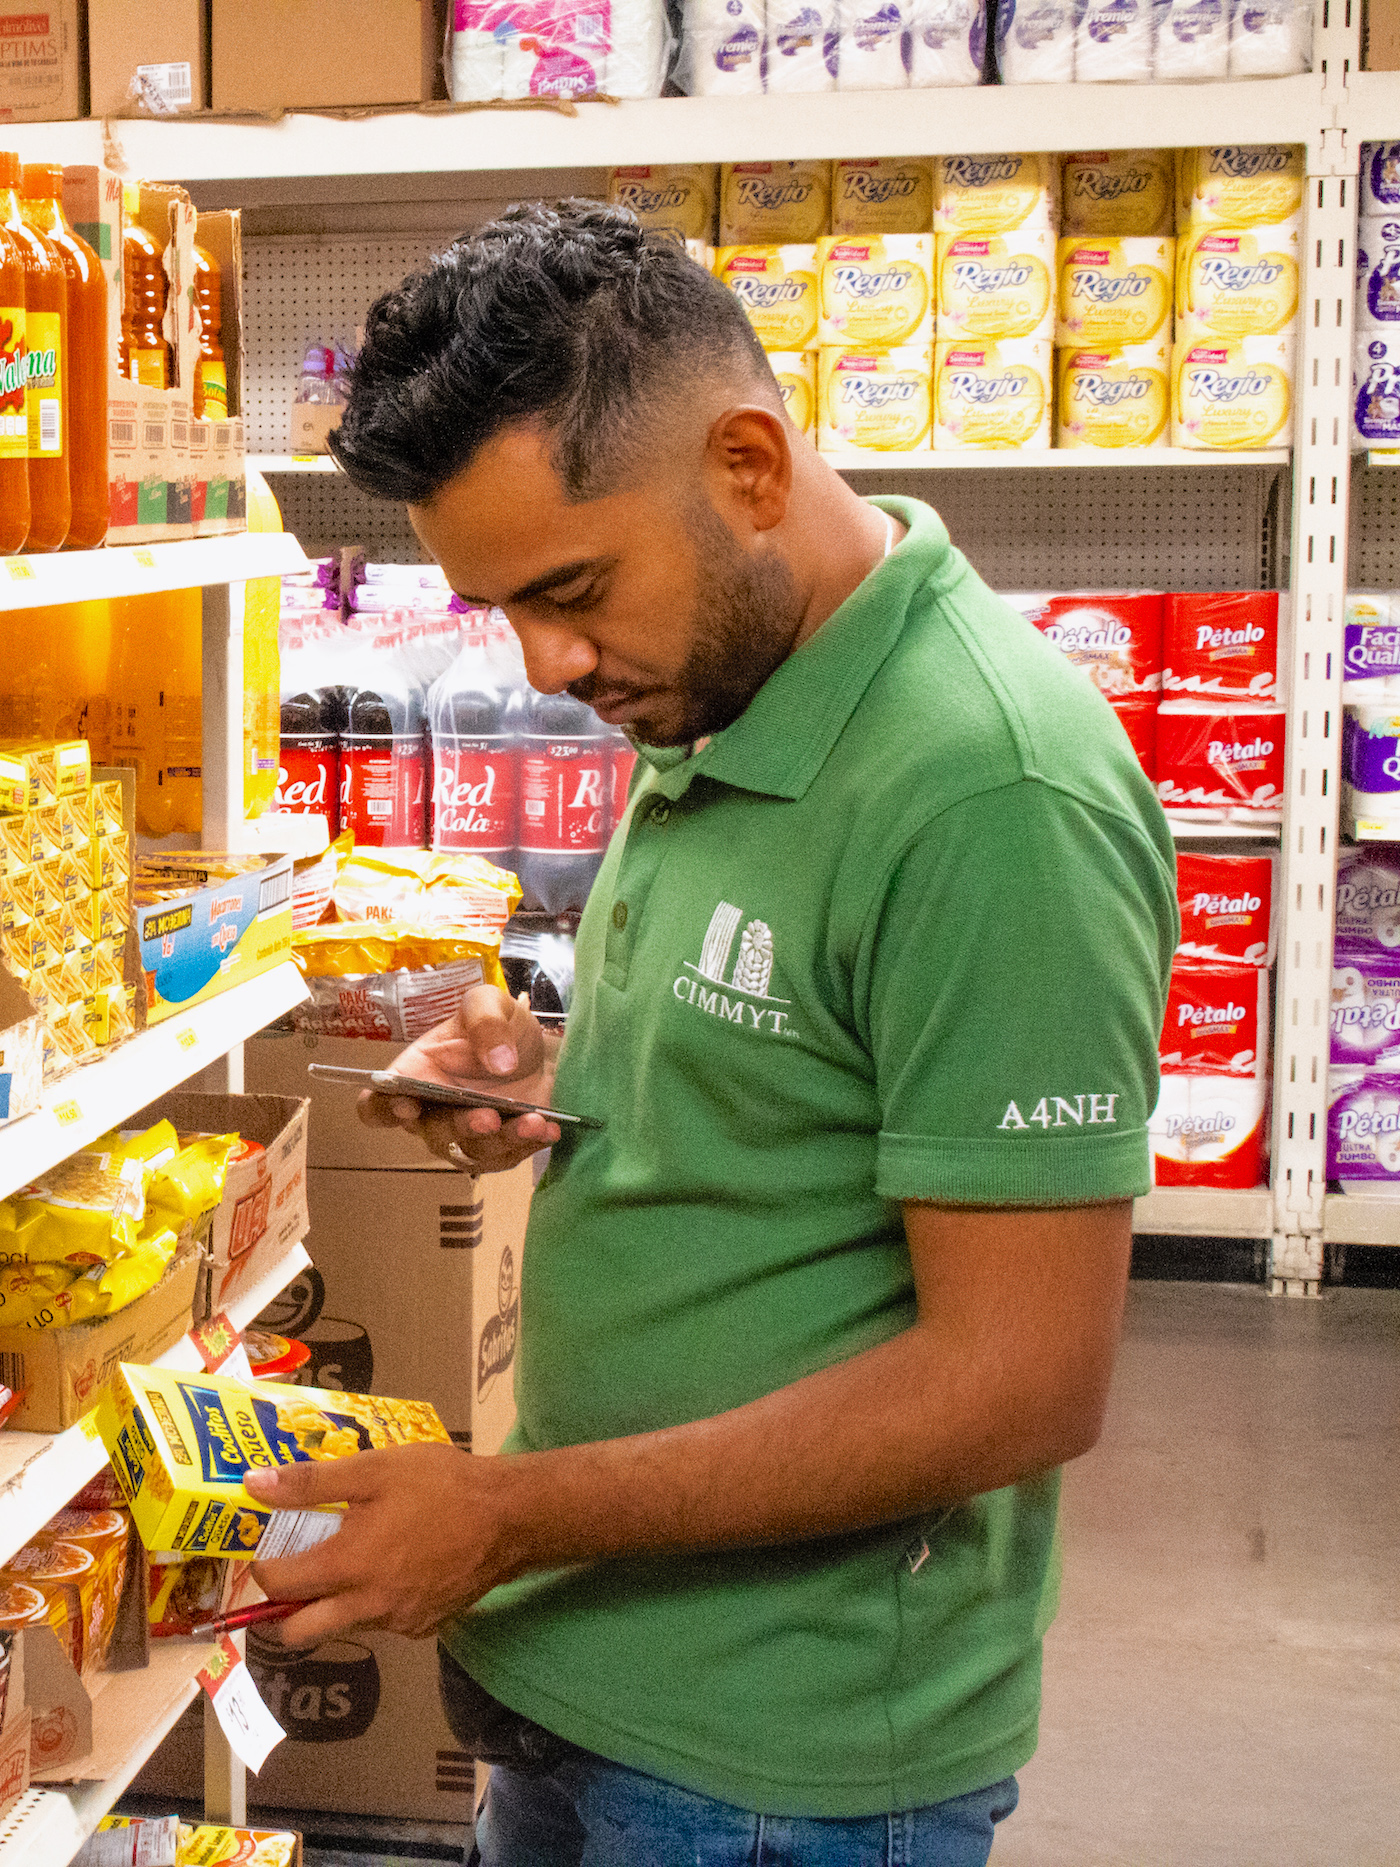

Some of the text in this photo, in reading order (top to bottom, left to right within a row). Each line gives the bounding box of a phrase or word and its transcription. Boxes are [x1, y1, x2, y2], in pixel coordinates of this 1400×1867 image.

[944, 156, 1023, 187] Regio
[1209, 148, 1293, 179] Regio
[738, 178, 812, 210] Regio
[844, 172, 919, 203] Regio
[1074, 168, 1152, 200] Regio
[833, 266, 911, 298] Regio
[954, 262, 1033, 293] Regio
[1072, 270, 1151, 303] Regio
[1200, 257, 1283, 290] Regio
[731, 277, 808, 308] Regio
[842, 376, 919, 407] Regio
[949, 371, 1028, 404] Regio
[1074, 374, 1153, 405] Regio
[1189, 369, 1272, 401] Regio
[1043, 620, 1132, 653] Pétalo
[1195, 622, 1266, 652] Pétalo
[1207, 737, 1275, 764] Pétalo
[432, 765, 496, 807] Red
[439, 807, 491, 834] Cola
[1193, 891, 1262, 917] Pétalo
[671, 975, 789, 1035] CIMMYT
[1177, 1001, 1246, 1027] Pétalo
[996, 1092, 1120, 1130] A4NH
[1166, 1111, 1236, 1139] Pétalo
[1336, 1153, 1376, 1163] JUMBO
[204, 1404, 243, 1465] Coditos
